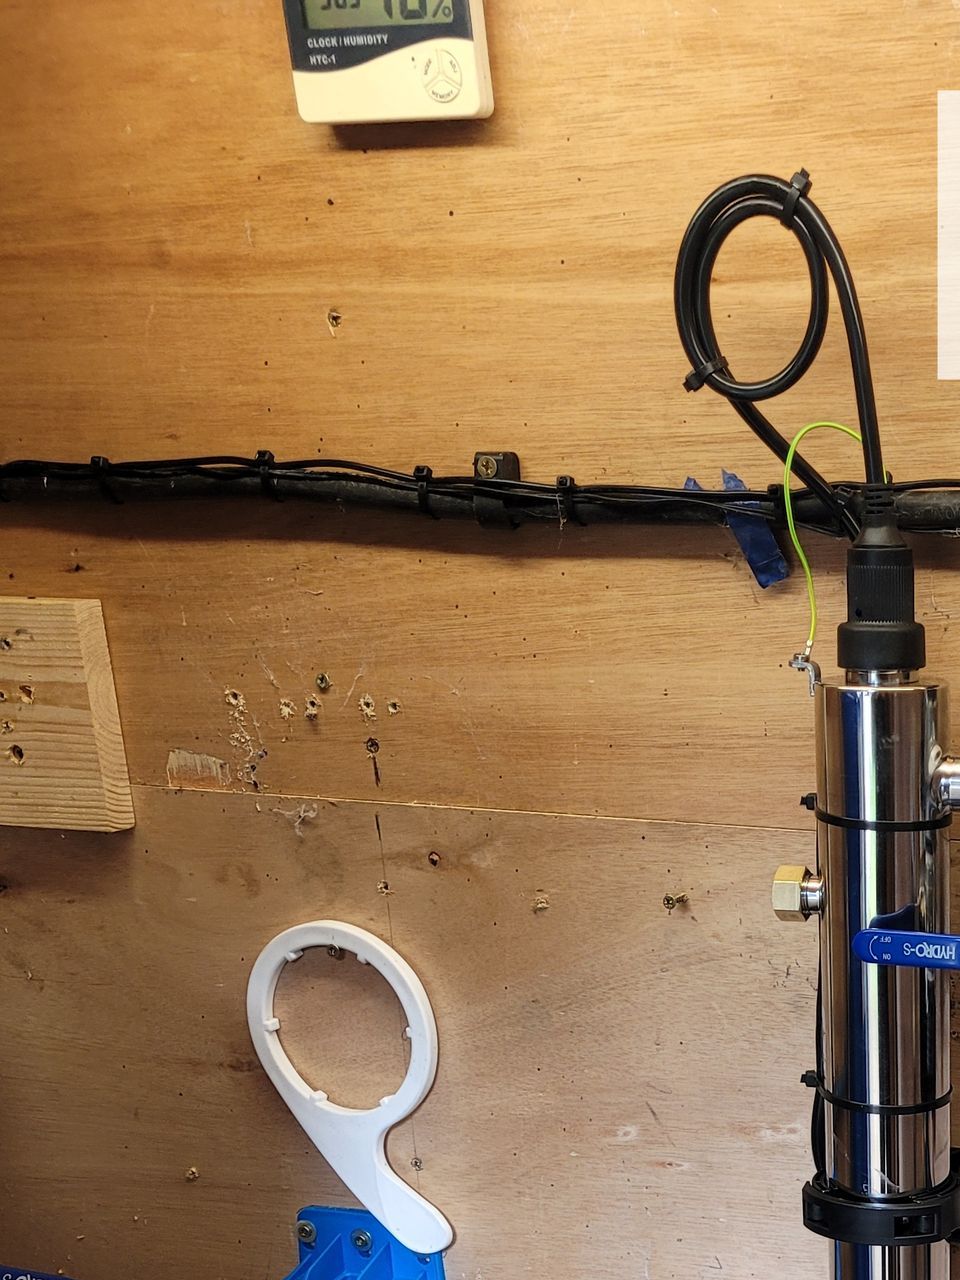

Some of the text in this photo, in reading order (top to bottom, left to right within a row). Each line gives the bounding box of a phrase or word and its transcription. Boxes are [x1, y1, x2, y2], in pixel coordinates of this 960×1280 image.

[307, 36, 338, 49] CLOCK
[343, 33, 388, 46] HUMIDITY
[879, 935, 892, 943] OFF
[903, 941, 956, 960] HYDRO-S
[882, 953, 892, 961] ON
